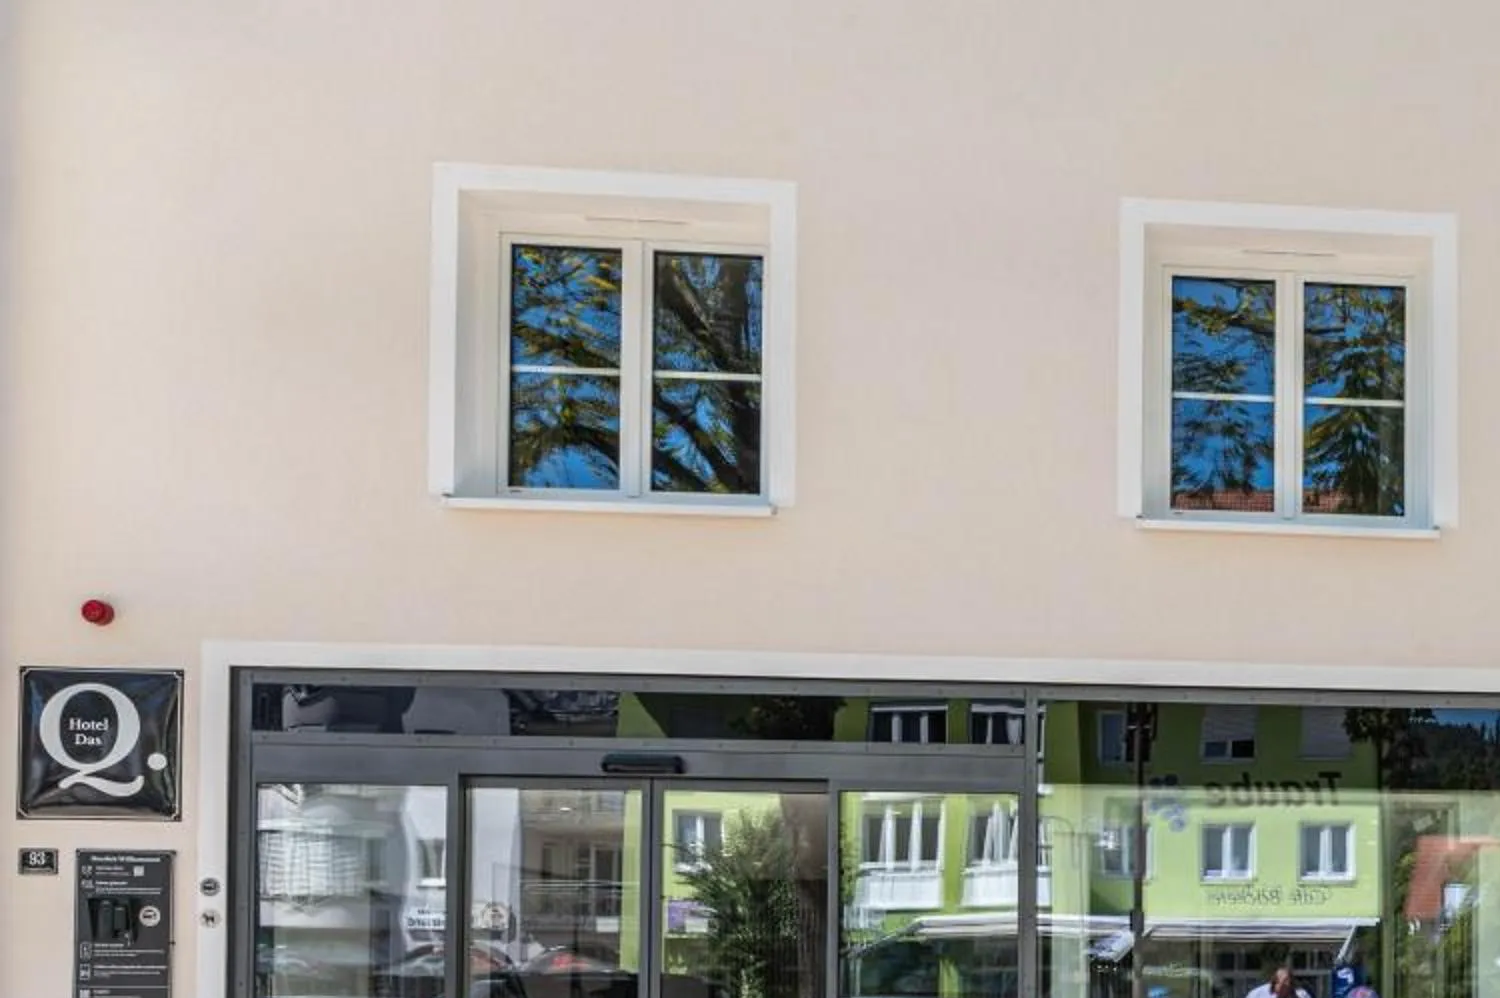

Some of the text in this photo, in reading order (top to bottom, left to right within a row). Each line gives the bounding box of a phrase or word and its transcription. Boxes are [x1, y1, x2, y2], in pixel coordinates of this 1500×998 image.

[69, 717, 109, 731] Hotel
[74, 734, 104, 746] Das
[29, 851, 46, 866] 93
